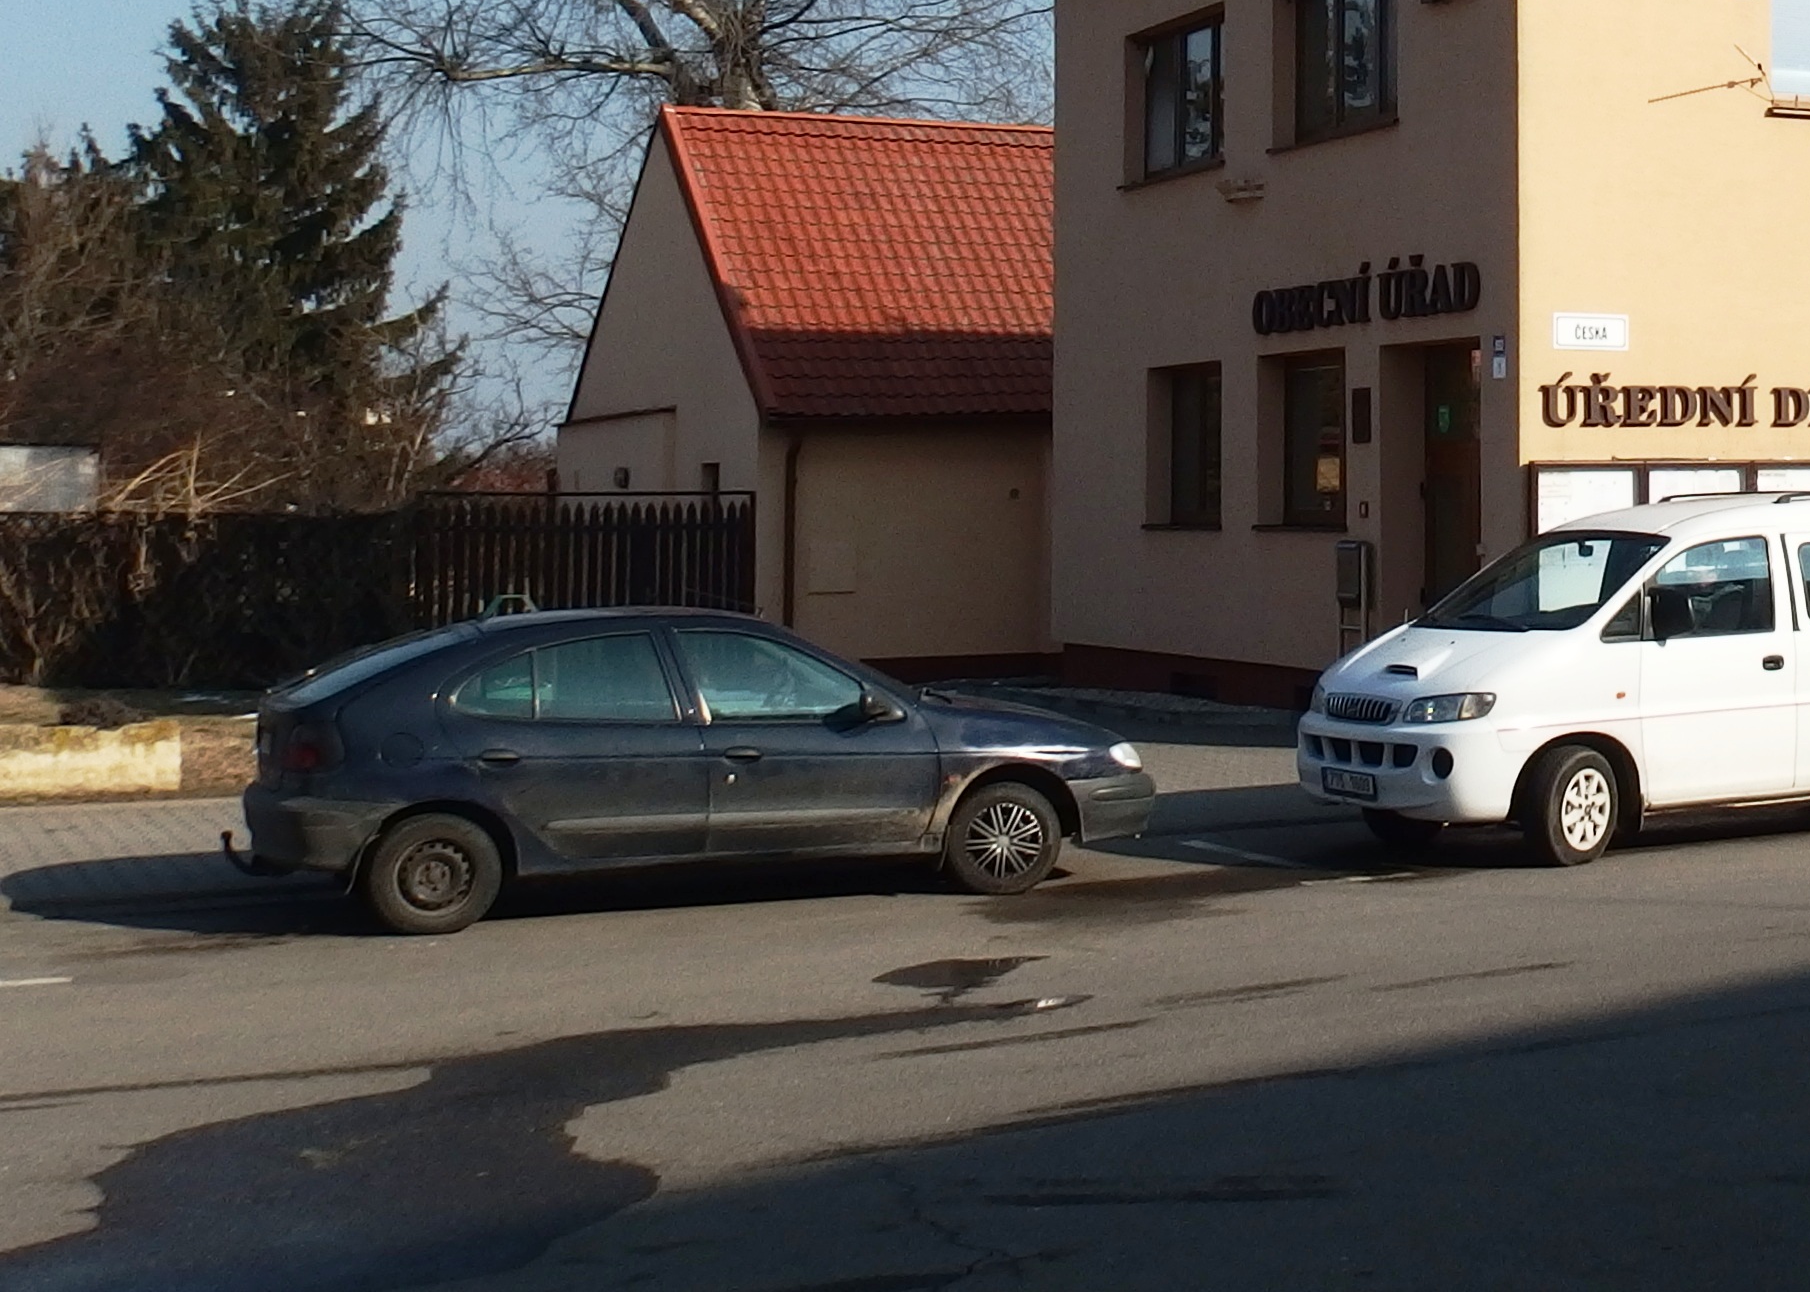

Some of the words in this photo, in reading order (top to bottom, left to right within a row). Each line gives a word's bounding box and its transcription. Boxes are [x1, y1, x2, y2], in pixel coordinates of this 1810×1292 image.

[1252, 261, 1372, 336] OBECNÍ
[1377, 254, 1481, 320] ÚŘAD
[1537, 371, 1758, 427] ÚŘEDNÍ
